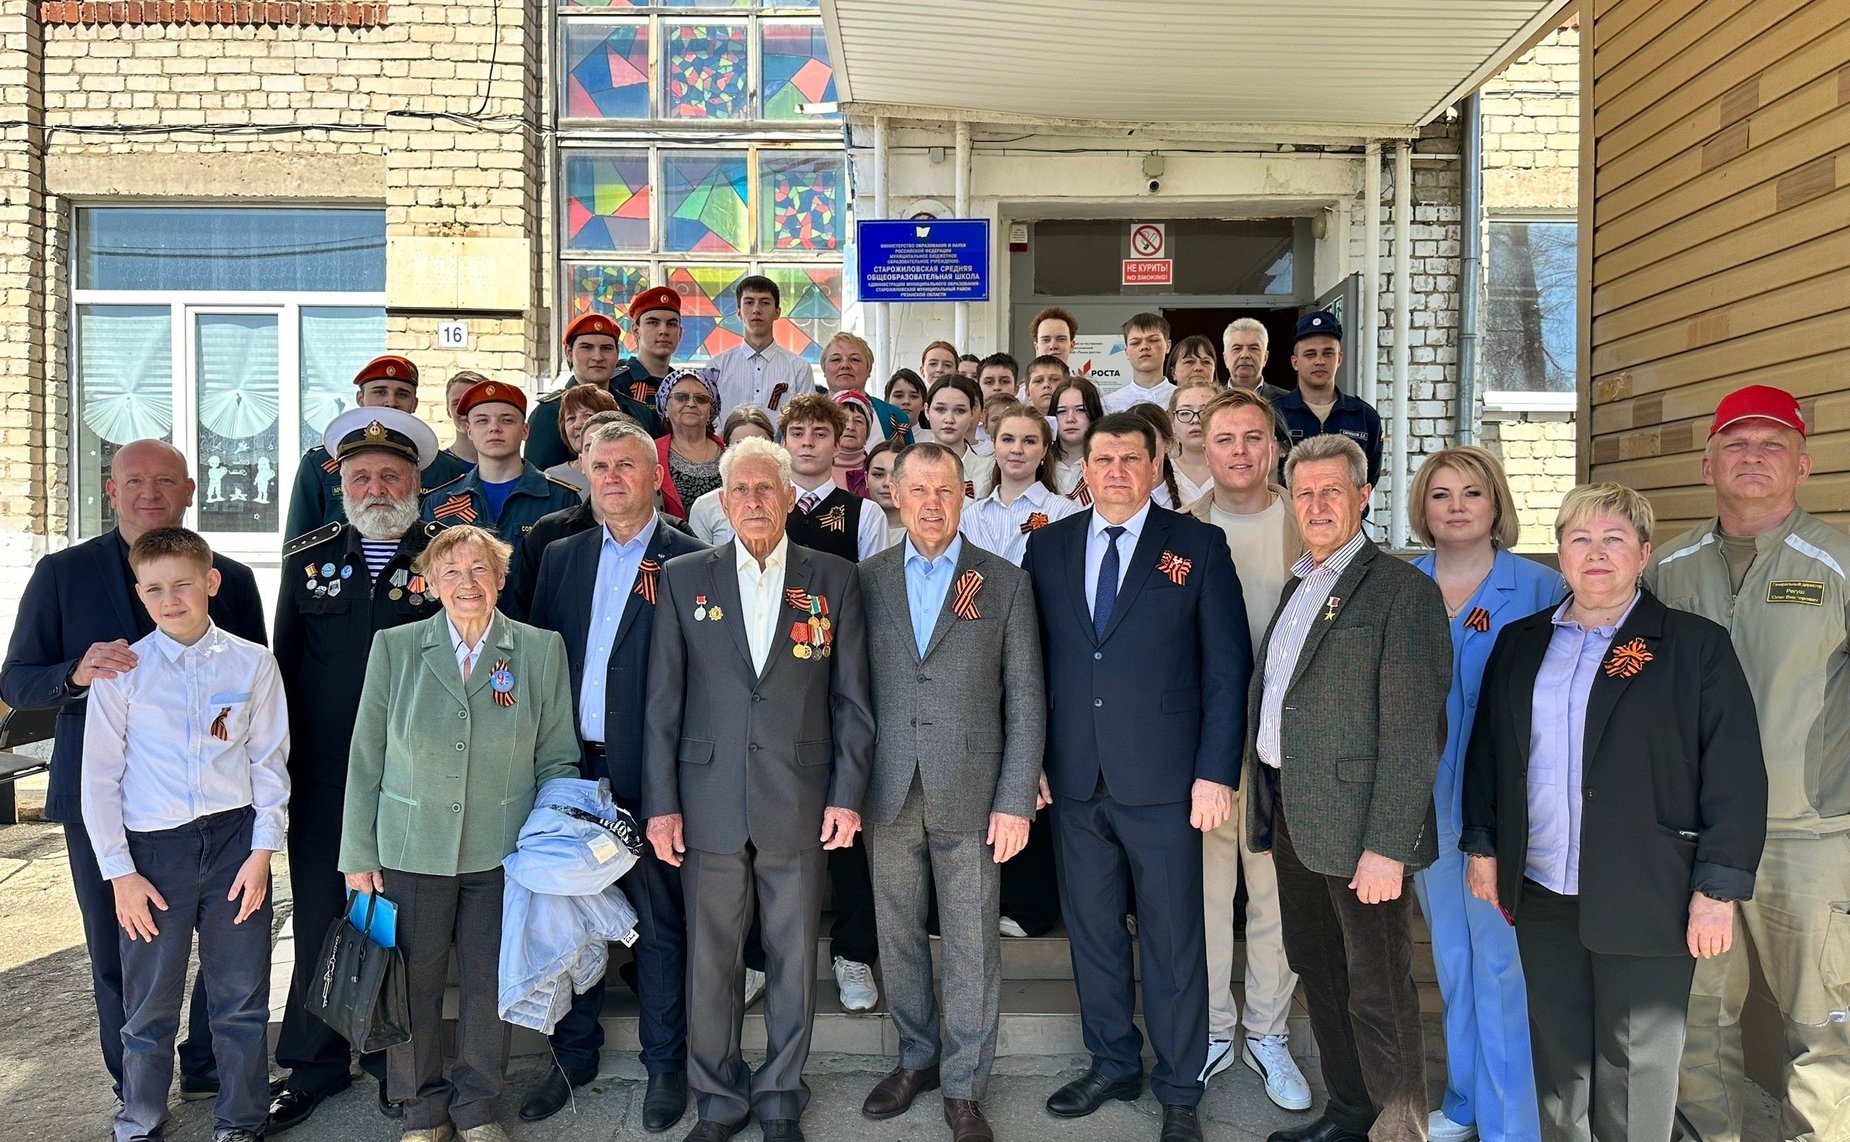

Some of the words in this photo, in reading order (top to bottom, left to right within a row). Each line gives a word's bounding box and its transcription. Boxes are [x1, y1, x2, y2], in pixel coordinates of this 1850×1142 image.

[940, 265, 973, 273] СРЕДНЯЯ
[1126, 263, 1137, 273] НЕ
[1138, 263, 1169, 273] КУРИТЬ!
[443, 326, 462, 343] 16
